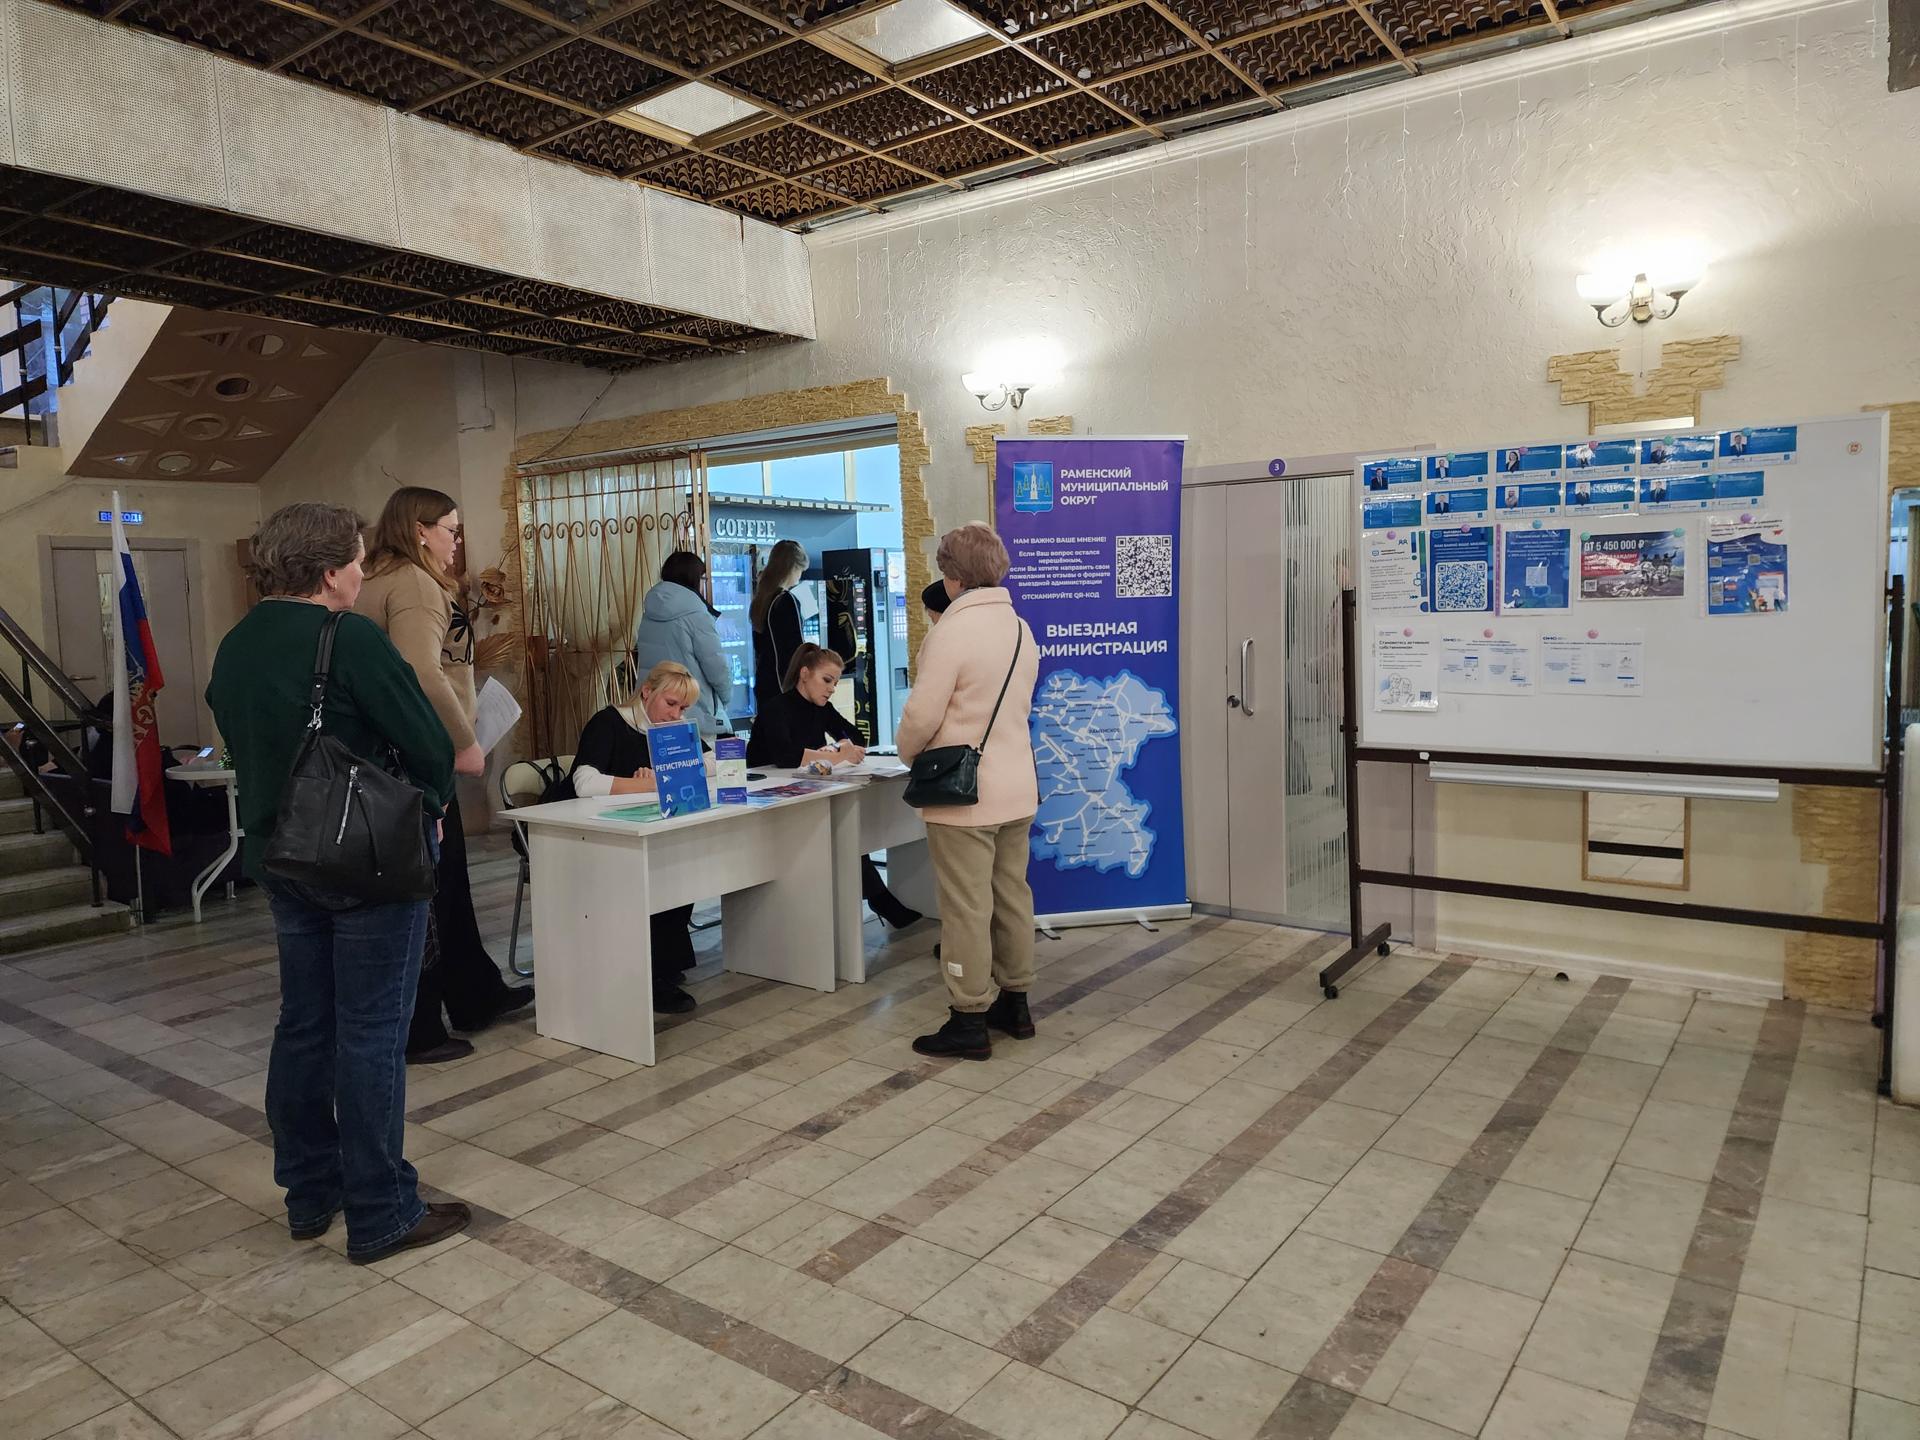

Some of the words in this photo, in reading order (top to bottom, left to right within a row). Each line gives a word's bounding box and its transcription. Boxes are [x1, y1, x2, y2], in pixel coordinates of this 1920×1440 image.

[1274, 463, 1279, 471] 3
[1060, 467, 1132, 479] РАМЕНСКИЙ
[1060, 480, 1169, 493] МУНИЦИПАЛЬНЫЙ
[1060, 495, 1098, 505] ОКРУГ
[100, 512, 138, 522] ВЫОД
[715, 517, 776, 538] COFFEE
[1584, 541, 1594, 551] ОТ
[1596, 541, 1602, 551] 5
[1603, 540, 1619, 550] 450
[1620, 541, 1636, 550] 000
[1082, 571, 1111, 579] формате
[1051, 579, 1102, 587] администрации
[1021, 591, 1073, 600] ОТСКАНИРУЙТЕ
[1074, 591, 1100, 600] QR-КОД
[1046, 621, 1138, 638] ВЫЕЗДНАЯ
[655, 758, 700, 773] РЕГИСТРАЦИЯ
